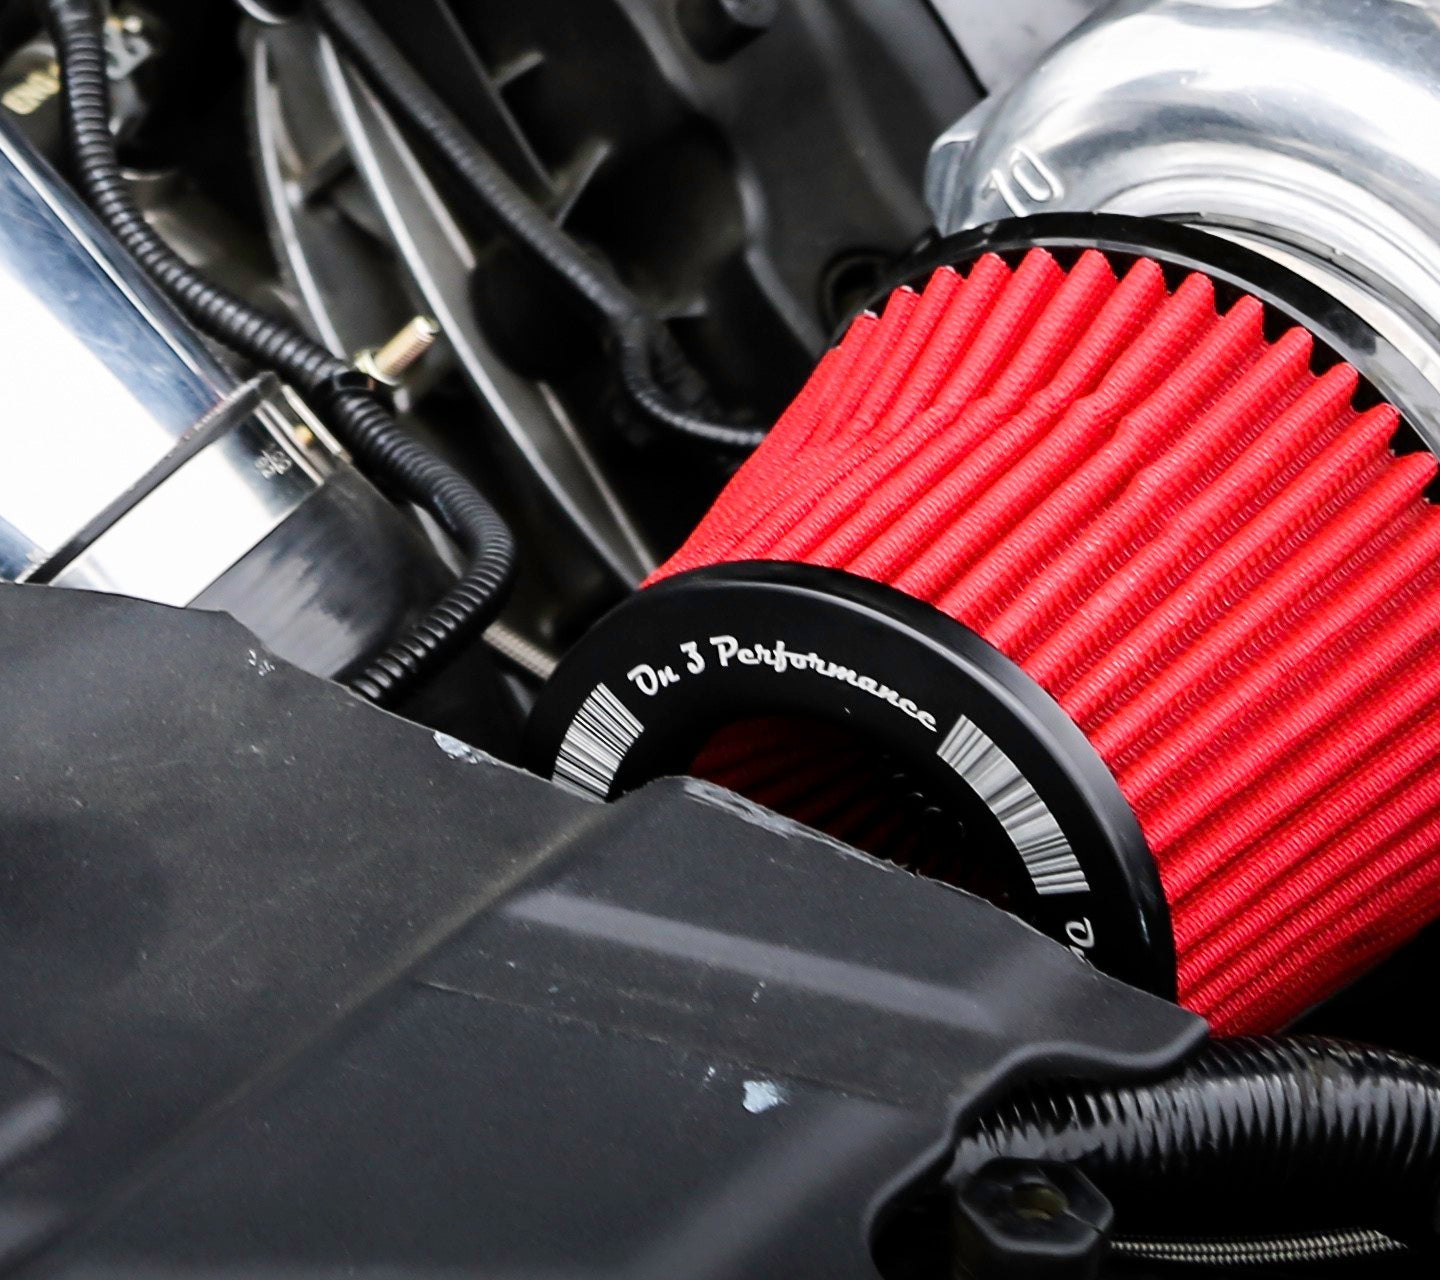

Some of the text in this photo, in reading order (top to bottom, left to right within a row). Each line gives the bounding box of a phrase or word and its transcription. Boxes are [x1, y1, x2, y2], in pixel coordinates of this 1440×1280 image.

[626, 634, 938, 733] On 3 Performance
